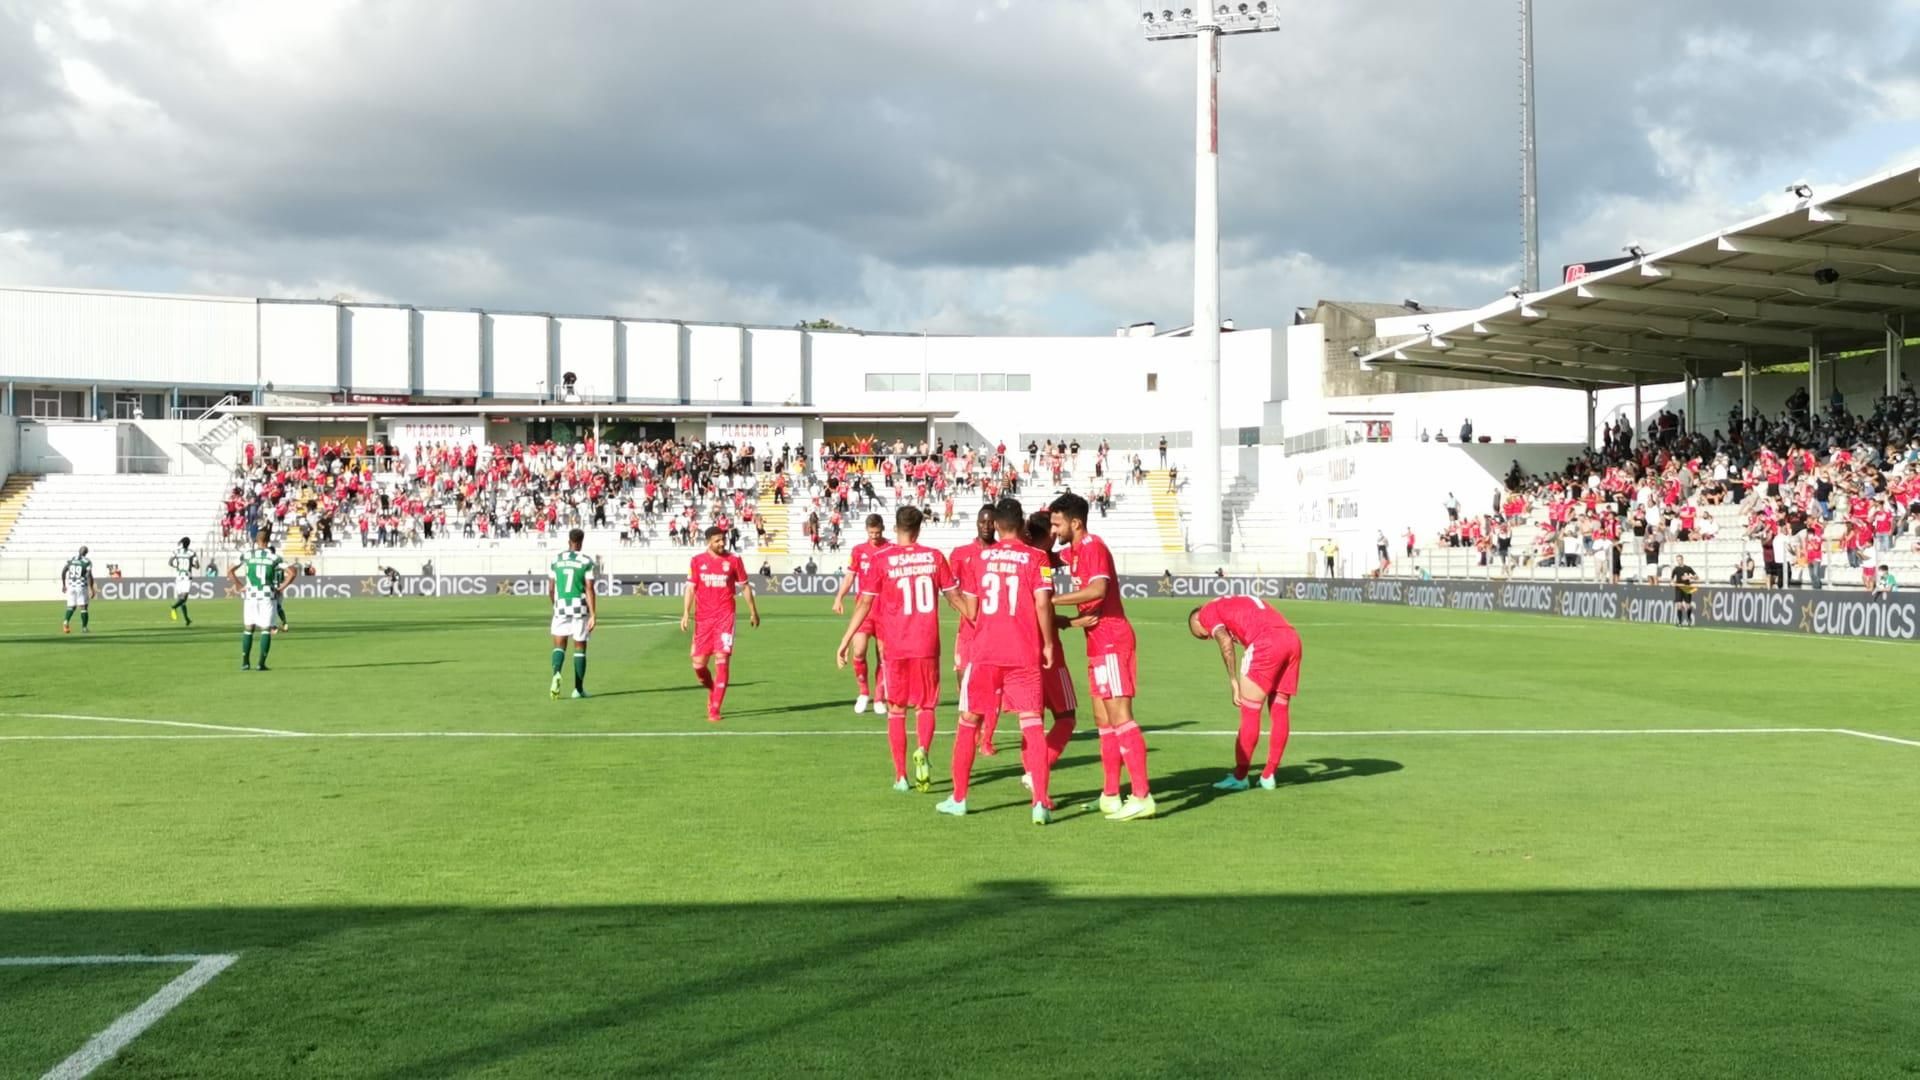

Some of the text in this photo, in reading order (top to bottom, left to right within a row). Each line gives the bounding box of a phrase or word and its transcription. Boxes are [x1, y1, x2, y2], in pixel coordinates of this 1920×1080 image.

[721, 424, 769, 438] PLACARD
[69, 564, 82, 577] 99
[563, 568, 574, 592] 7
[101, 581, 214, 600] euroncs
[897, 575, 934, 616] 10
[981, 573, 1019, 616] 31
[1173, 577, 1279, 596] euronics
[1295, 581, 1328, 600] euronics
[1368, 580, 1402, 601] euronics
[1407, 584, 1446, 608] euronics
[1503, 584, 1552, 610] euronics
[1452, 588, 1495, 612] euronics
[1562, 589, 1618, 619] euronics
[1712, 591, 1795, 626] euronics
[1813, 597, 1916, 639] euronics
